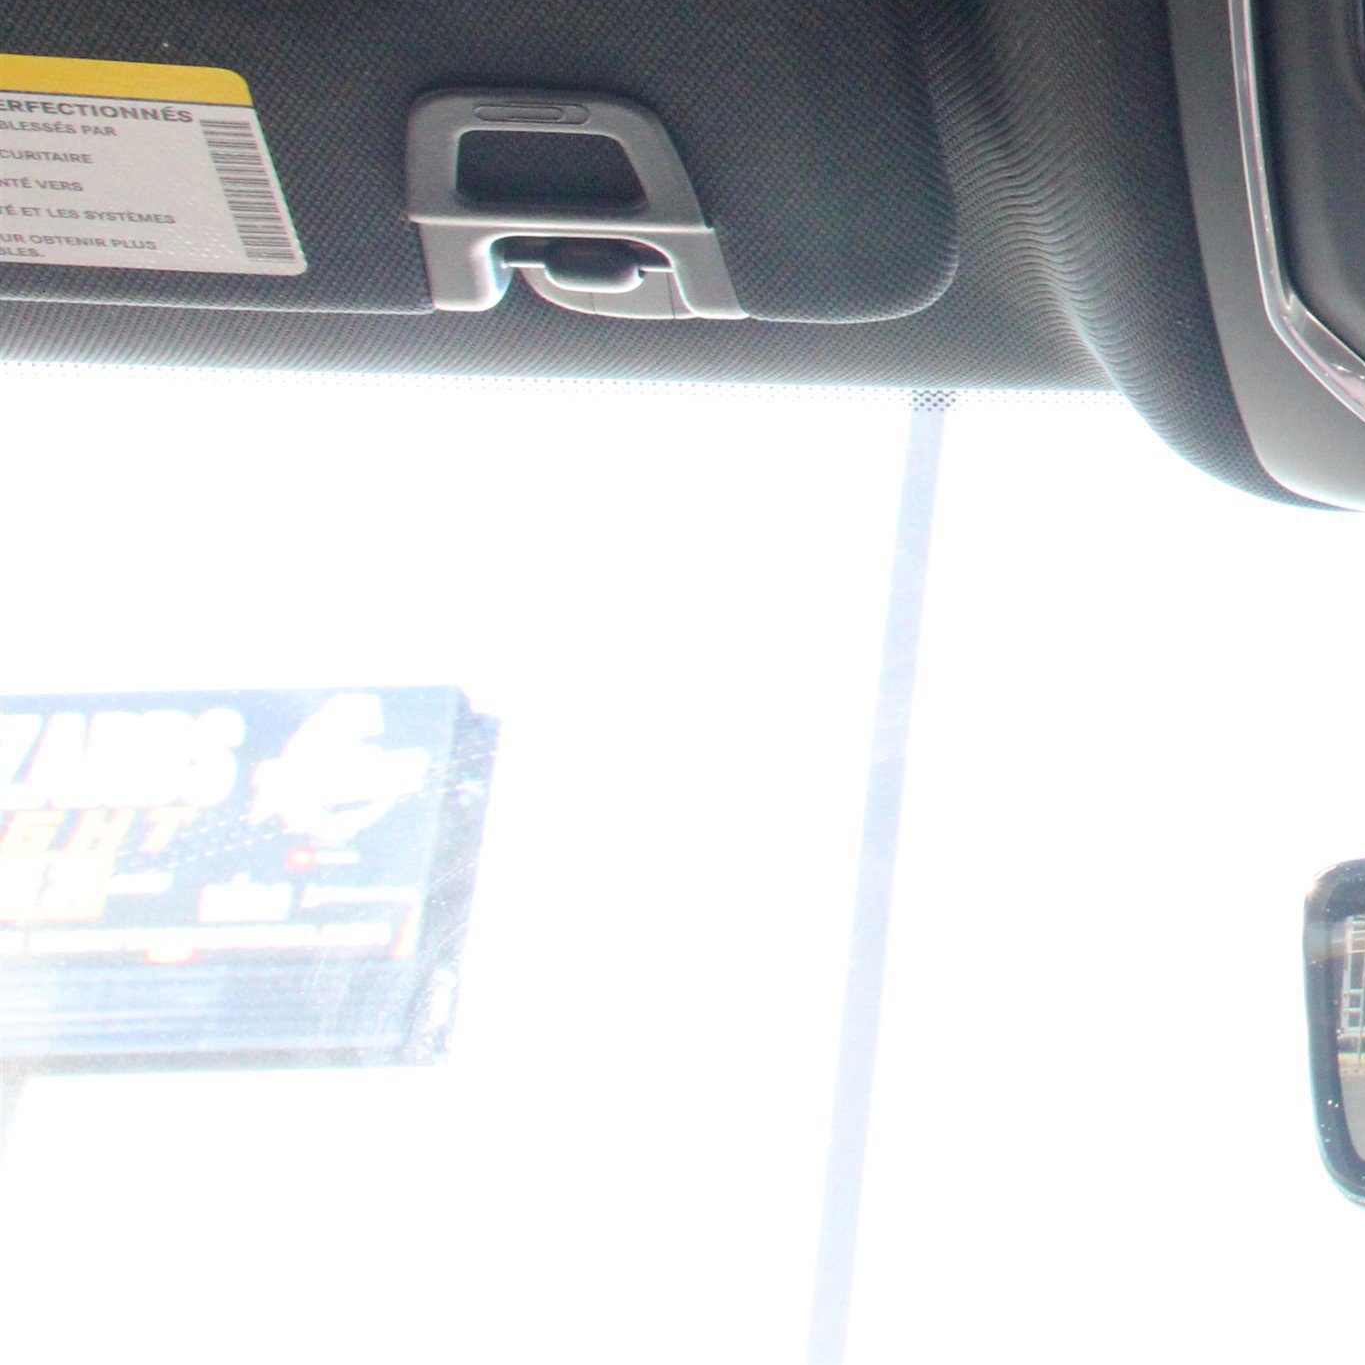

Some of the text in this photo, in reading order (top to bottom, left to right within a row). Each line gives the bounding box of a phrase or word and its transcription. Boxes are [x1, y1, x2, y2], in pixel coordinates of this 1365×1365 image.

[81, 125, 117, 137] PAR
[35, 180, 84, 192] VERS
[20, 207, 42, 217] ET
[47, 209, 80, 220] LES
[83, 210, 177, 225] SYSTÈMES
[29, 235, 108, 248] OBTENIR
[110, 238, 158, 251] PLUS
